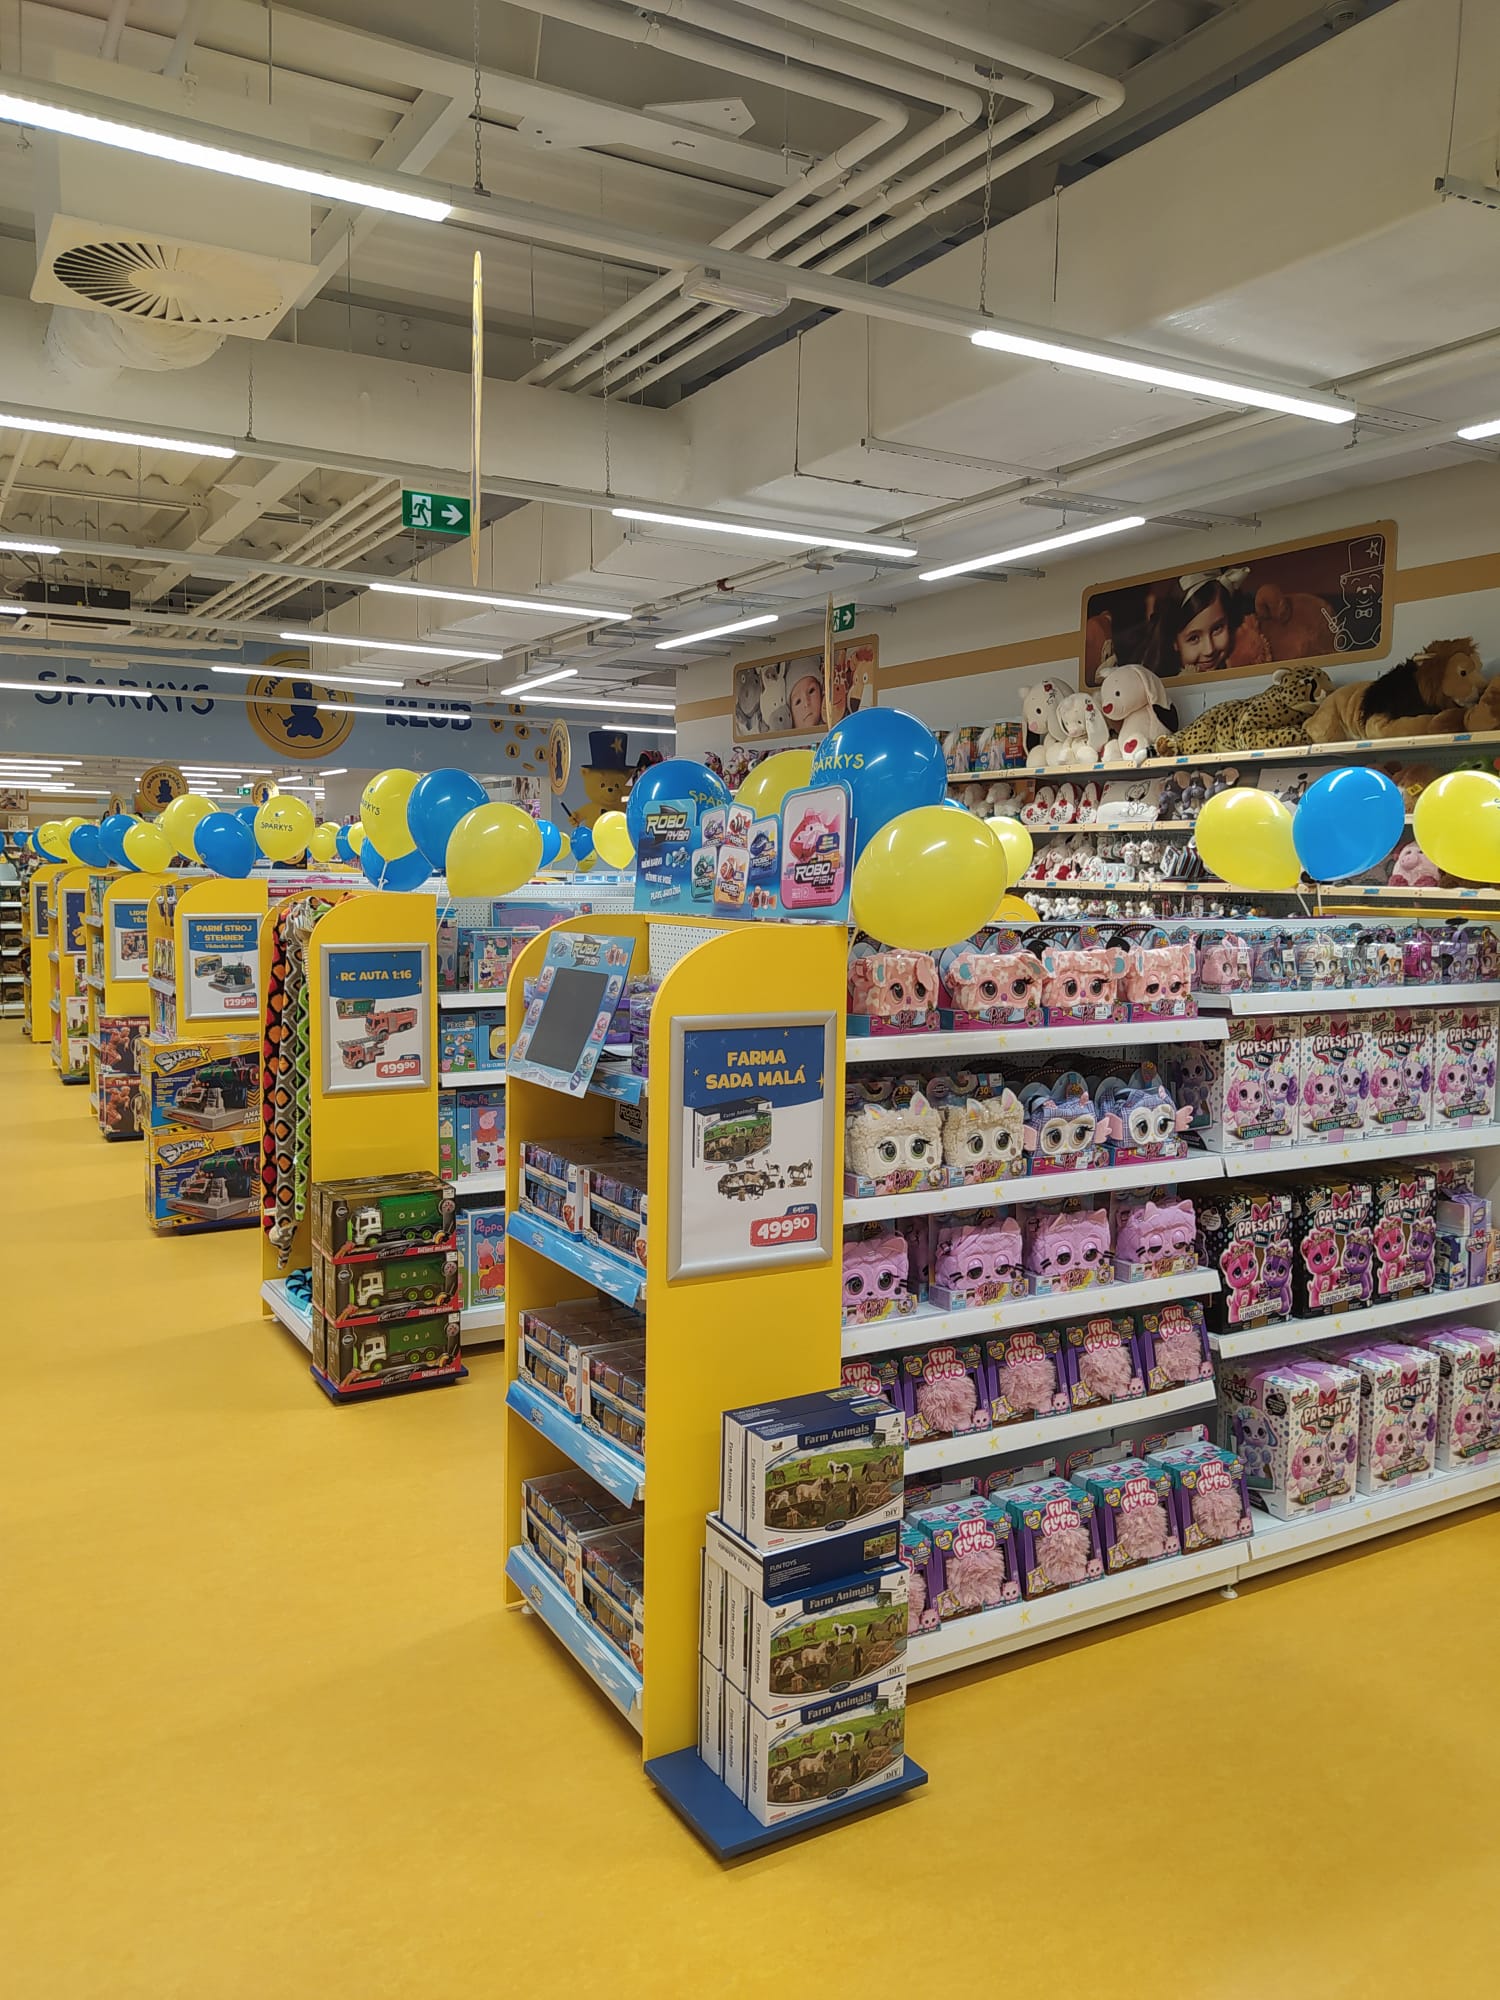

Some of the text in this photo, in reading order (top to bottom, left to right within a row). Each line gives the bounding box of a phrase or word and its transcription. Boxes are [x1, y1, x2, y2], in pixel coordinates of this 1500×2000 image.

[35, 671, 214, 715] SPARKYS
[814, 753, 864, 772] PARKYS
[689, 790, 724, 806] SPAR
[261, 822, 293, 832] SPARKYS
[646, 814, 687, 834] ROBO
[665, 830, 691, 841] RYBA
[795, 863, 830, 881] ROBO
[813, 874, 834, 885] FISH
[196, 923, 252, 932] PARNÍ STROJ
[572, 943, 599, 958] ROBO
[340, 970, 412, 982] RC AUTA 1:16
[1316, 1034, 1362, 1052] PRESENT
[1382, 1029, 1424, 1046] PRESENT
[1449, 1026, 1489, 1043] PRESENT
[1240, 1039, 1289, 1057] PRESENT
[727, 1049, 787, 1067] FARMA
[705, 1064, 806, 1090] SADA MALÁ
[1388, 1194, 1428, 1213] PRESENT
[1319, 1205, 1364, 1224] PRESENT
[476, 1218, 503, 1236] Peppa
[1239, 1216, 1284, 1237] PRESENT
[1164, 1307, 1183, 1320] FUR
[1090, 1321, 1111, 1334] FUR
[1160, 1320, 1192, 1339] FLUFFS
[1012, 1335, 1034, 1348] FUR
[1085, 1334, 1120, 1352] FLUFFS
[930, 1350, 954, 1363] FUR
[1008, 1349, 1044, 1367] FLUFFS
[844, 1365, 870, 1379] FUR
[925, 1364, 964, 1385] FLUFFS
[1466, 1362, 1500, 1384] PRESEN
[1386, 1380, 1431, 1402] PRESENT
[1303, 1400, 1350, 1423] PRESENT
[804, 1423, 870, 1445] Farm Animals
[1202, 1463, 1222, 1476] FUR
[1127, 1480, 1148, 1493] FUR
[1198, 1476, 1231, 1495] FLUFFS
[1048, 1501, 1070, 1515] FUR
[1122, 1492, 1157, 1512] FLUFFS
[885, 1509, 898, 1518] DIY
[961, 1521, 984, 1535] FUR
[1042, 1515, 1079, 1535] FLUFFS
[954, 1536, 994, 1557] FLUFFS
[809, 1584, 875, 1609] Farm Animals
[807, 1692, 873, 1720] Farm Animals
[885, 1768, 899, 1779] DIY
